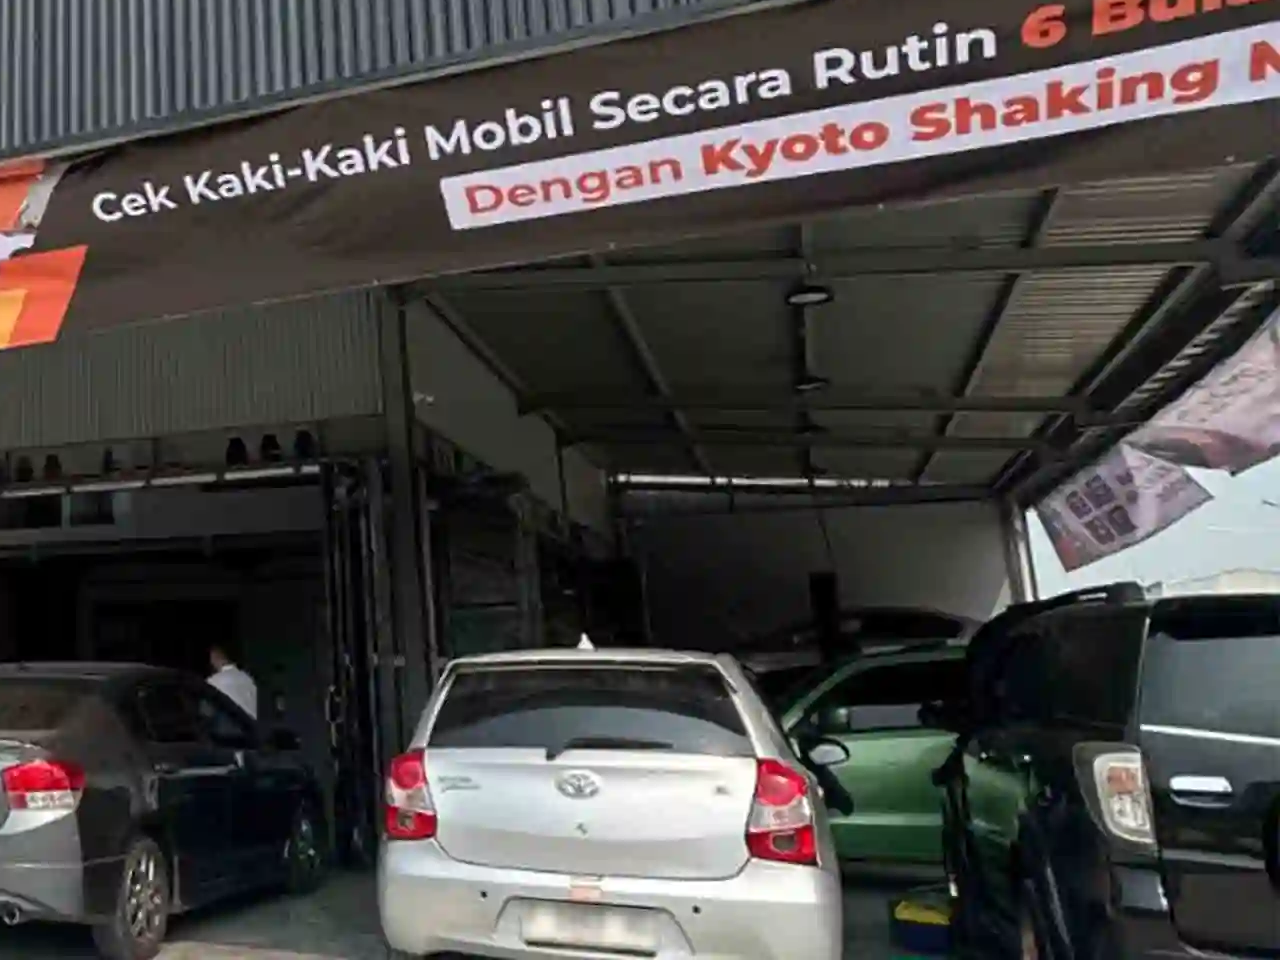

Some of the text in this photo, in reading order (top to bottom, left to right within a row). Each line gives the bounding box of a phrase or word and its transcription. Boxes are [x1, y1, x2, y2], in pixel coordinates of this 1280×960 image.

[91, 181, 178, 223] Cek
[183, 126, 411, 205] Kaki-Kaki
[423, 96, 575, 161] Mobil
[589, 67, 793, 130] Secara
[813, 21, 998, 90] Rutin
[1021, 3, 1068, 49] 6
[464, 157, 683, 215] Dengan
[700, 121, 890, 178] Kyoto
[909, 58, 1220, 142] Shaking
